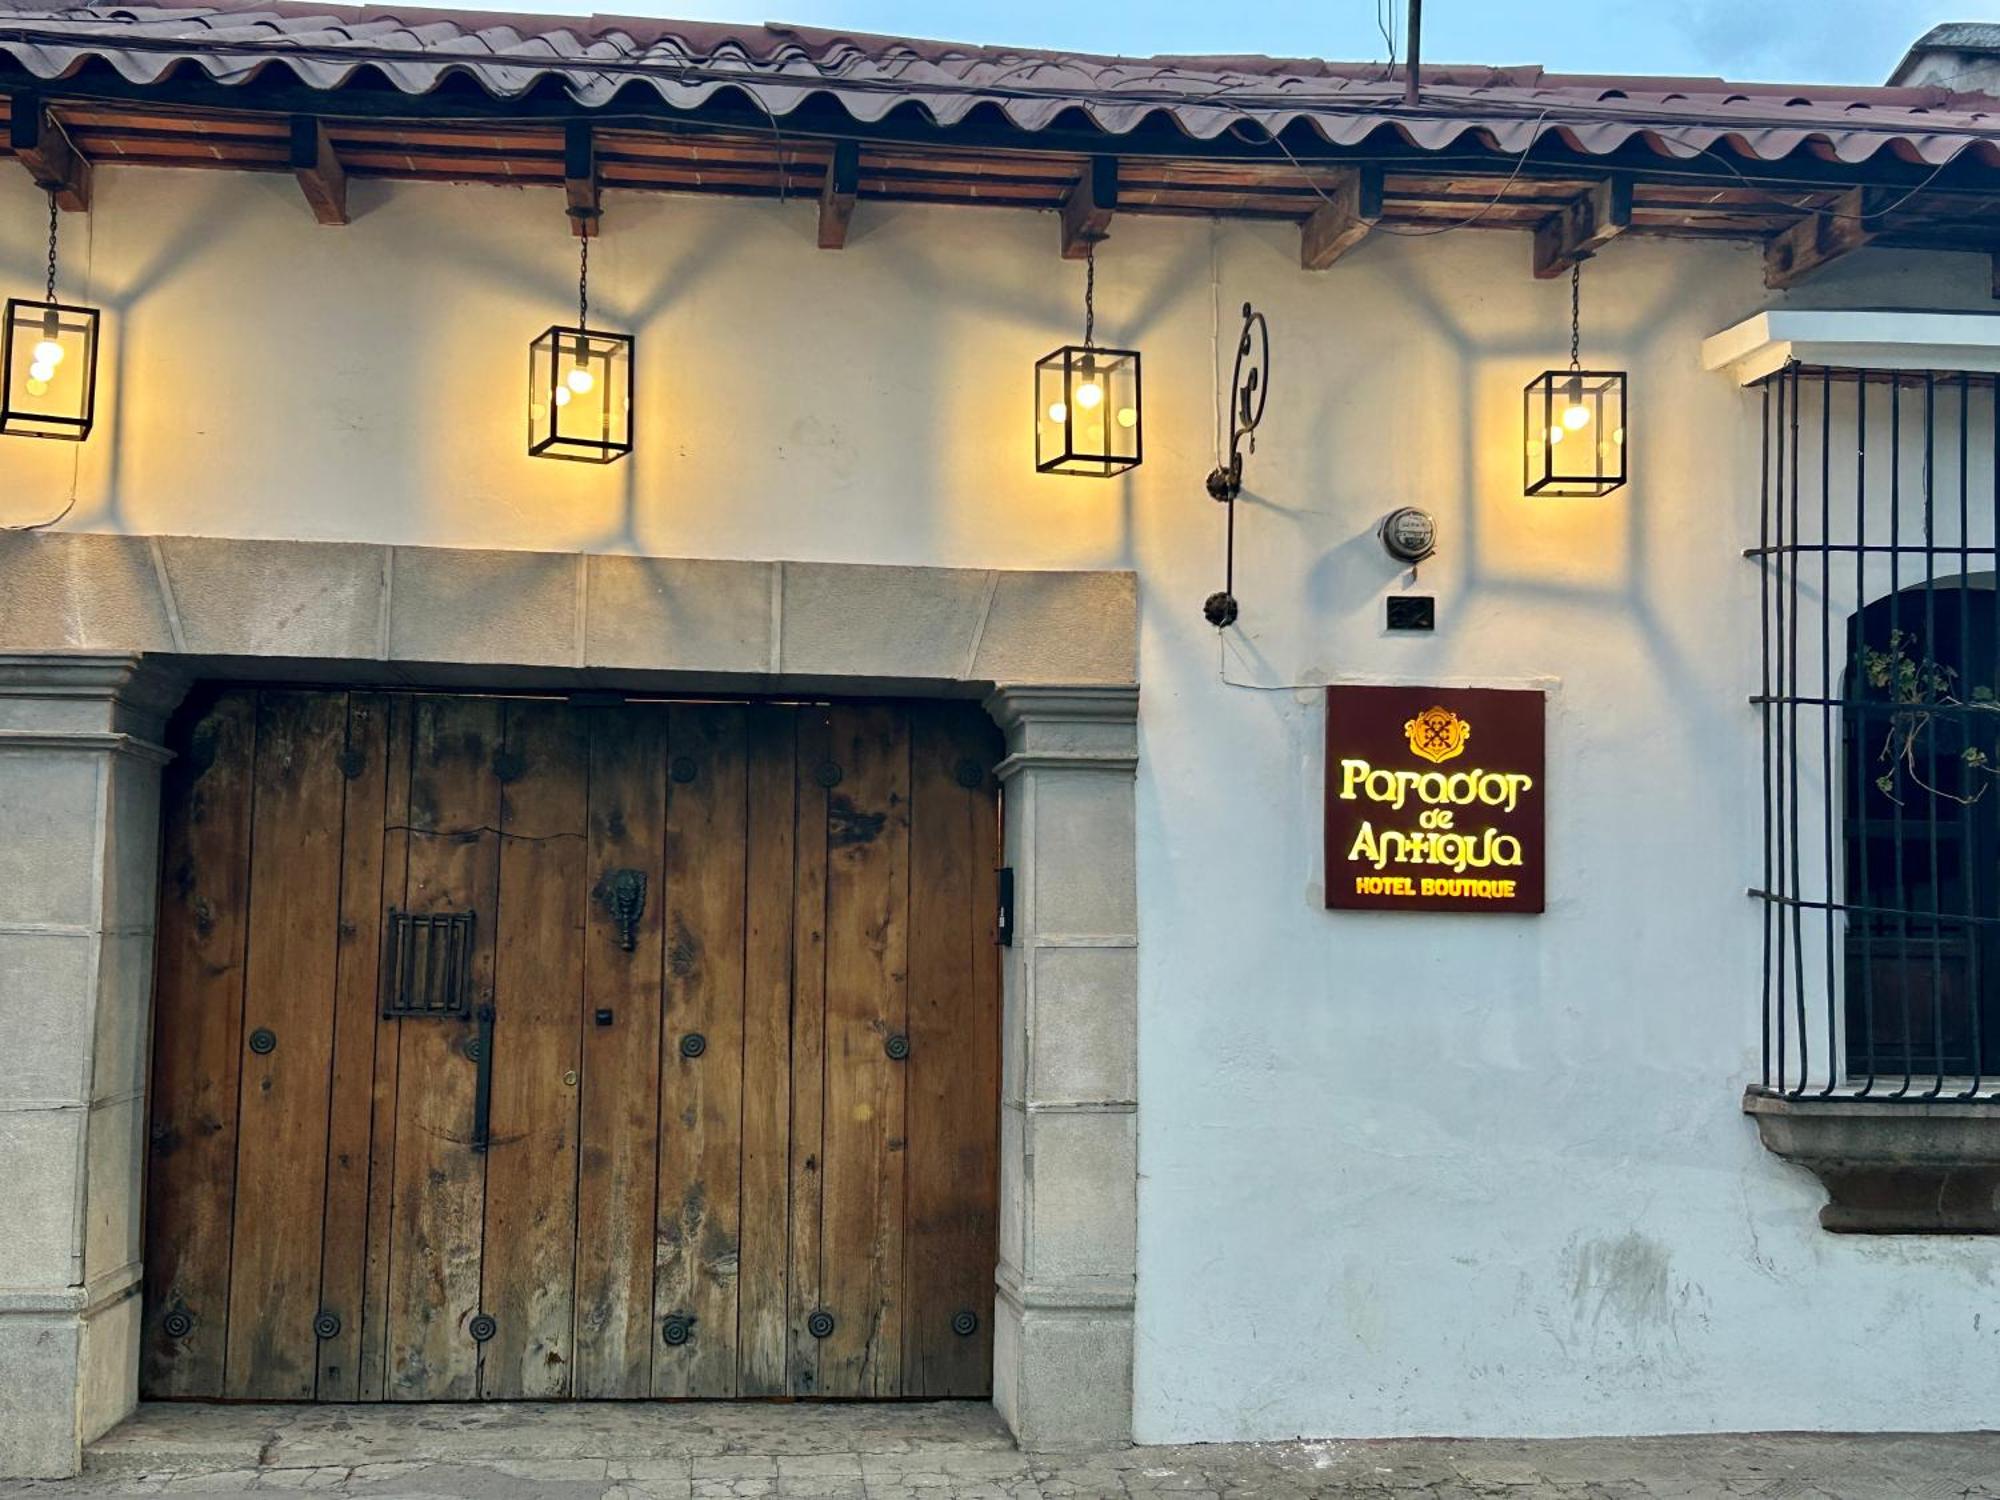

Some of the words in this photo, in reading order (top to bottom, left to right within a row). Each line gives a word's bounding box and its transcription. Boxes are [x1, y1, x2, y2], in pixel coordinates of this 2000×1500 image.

[1340, 759, 1533, 812] Parador
[1419, 808, 1455, 829] de
[1356, 877, 1416, 896] HOTEL
[1421, 877, 1516, 898] BOUTIQUE
